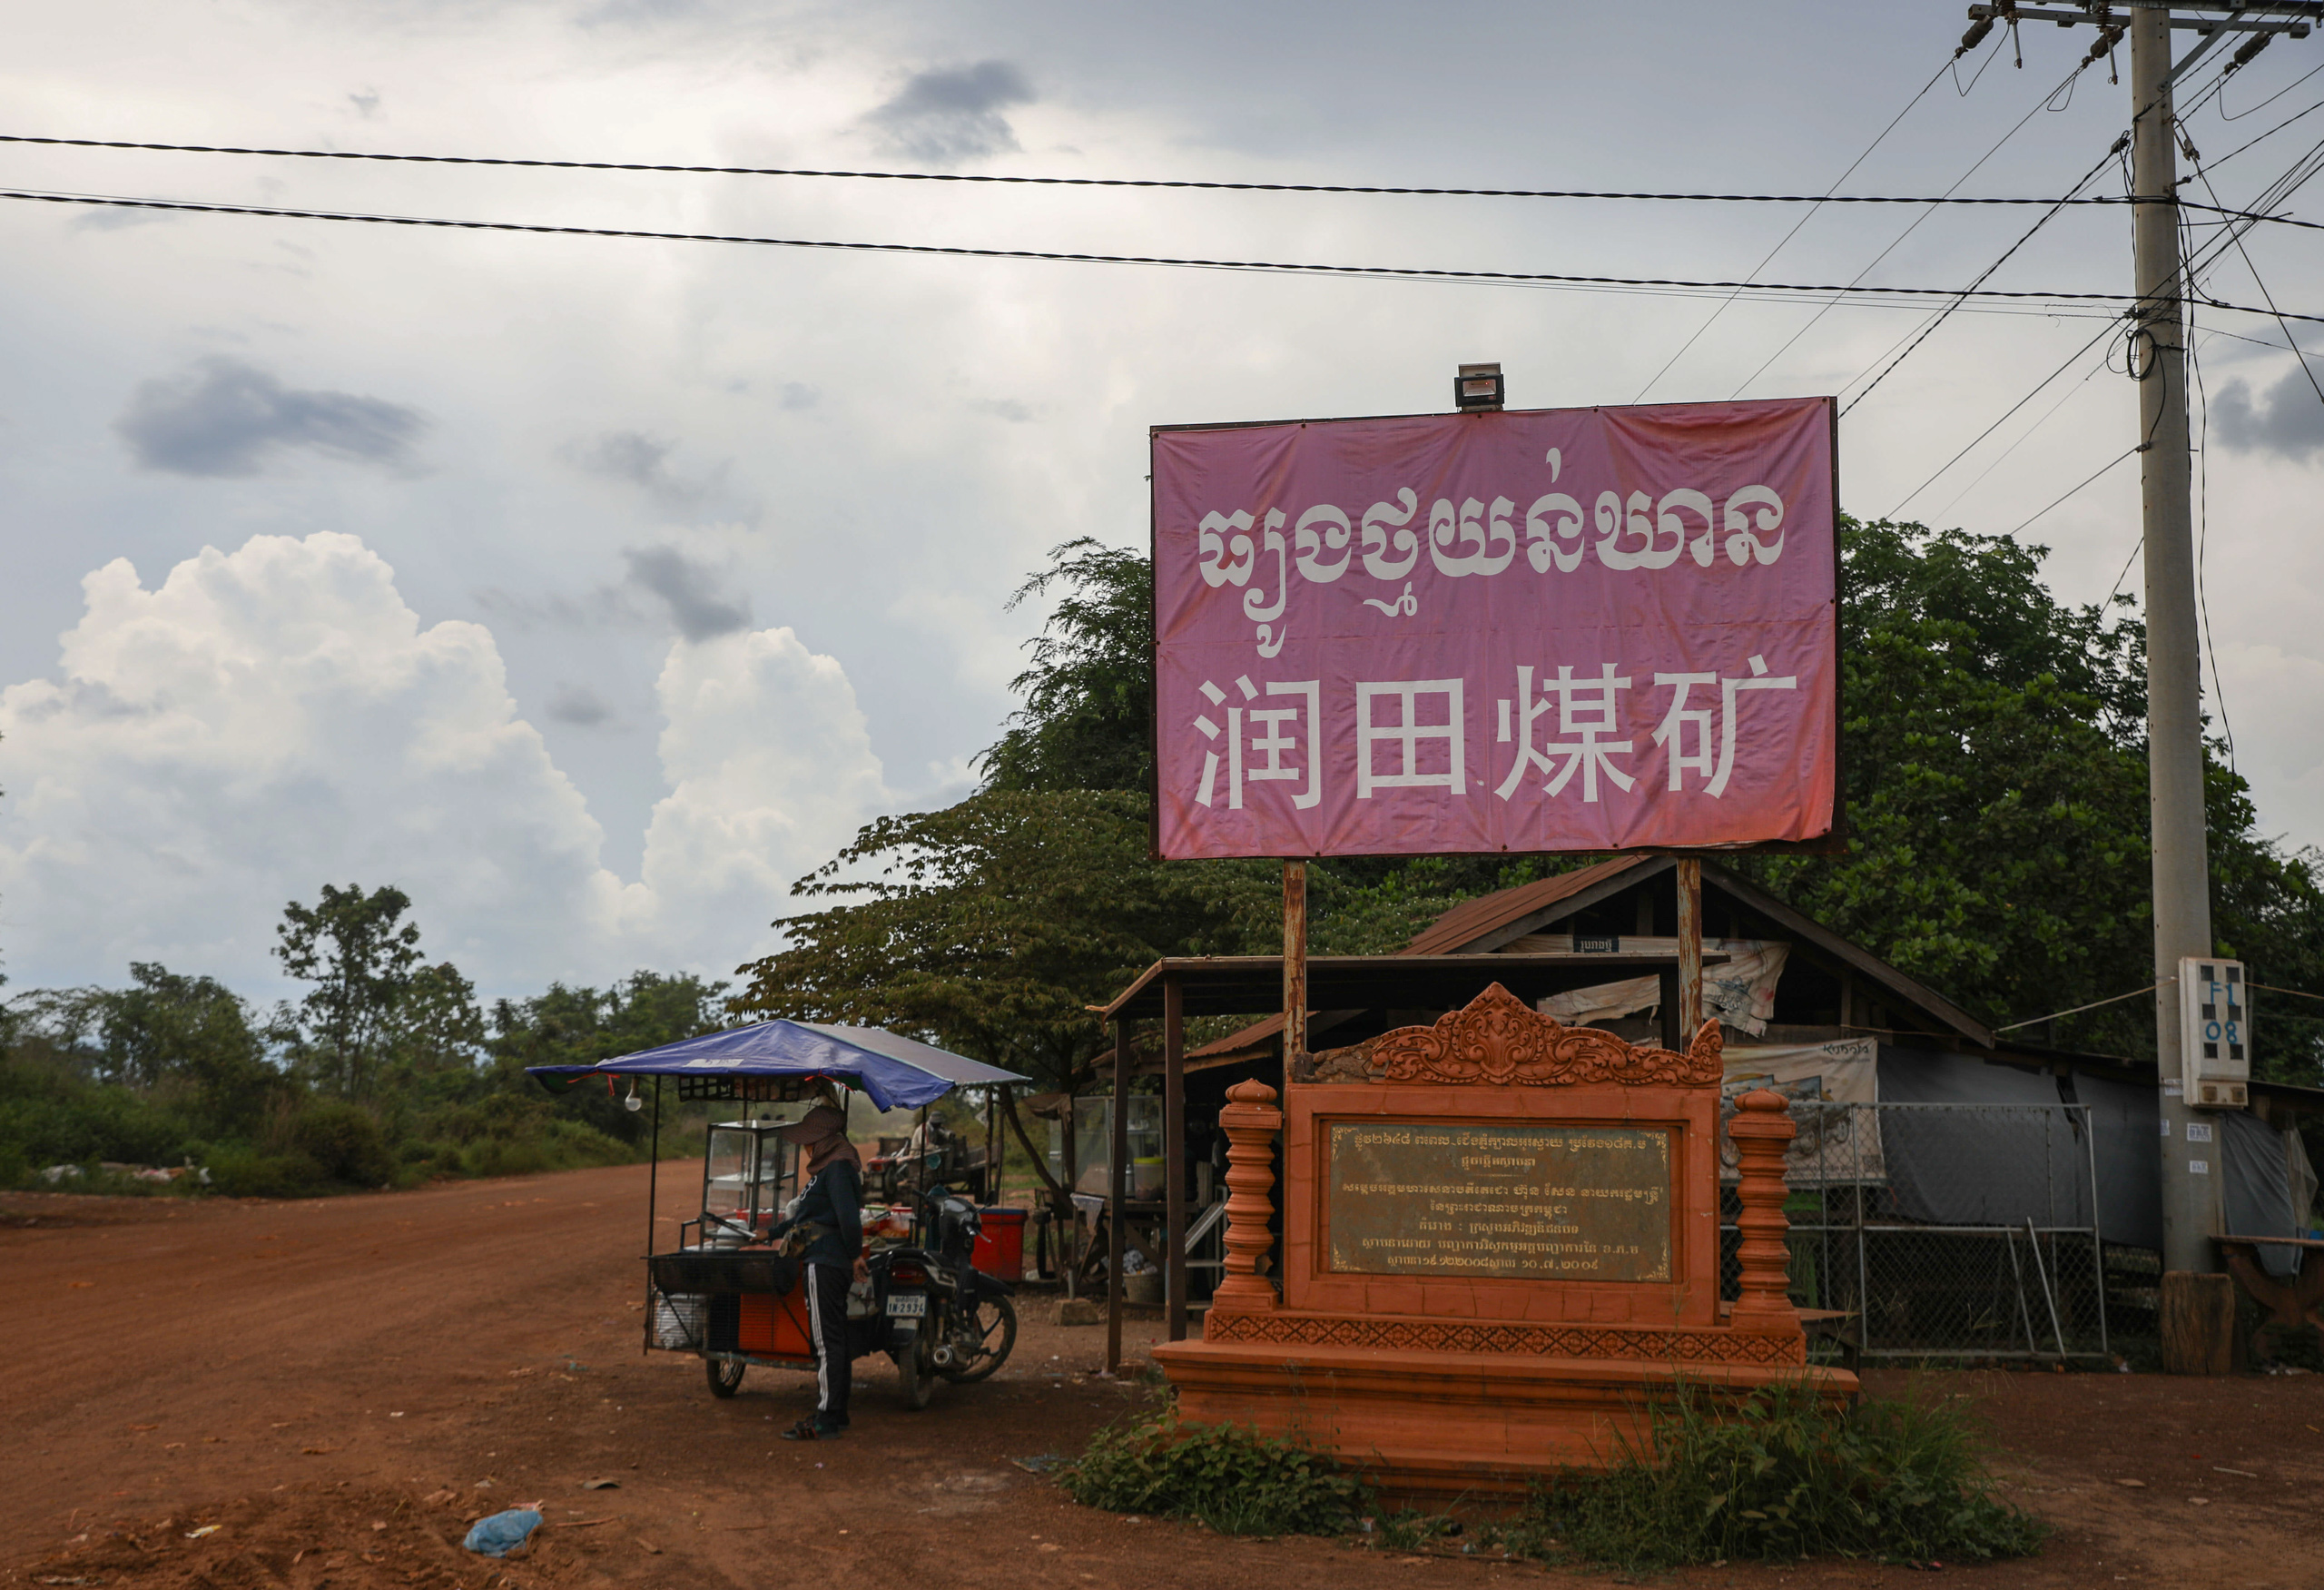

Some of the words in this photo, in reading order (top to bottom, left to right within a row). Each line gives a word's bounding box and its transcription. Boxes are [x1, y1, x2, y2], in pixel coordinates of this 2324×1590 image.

[1193, 654, 1797, 810] 润田煤矿
[2210, 982, 2236, 1005] F1
[2205, 1021, 2237, 1044] 08
[1544, 1182, 1576, 1196] សែន
